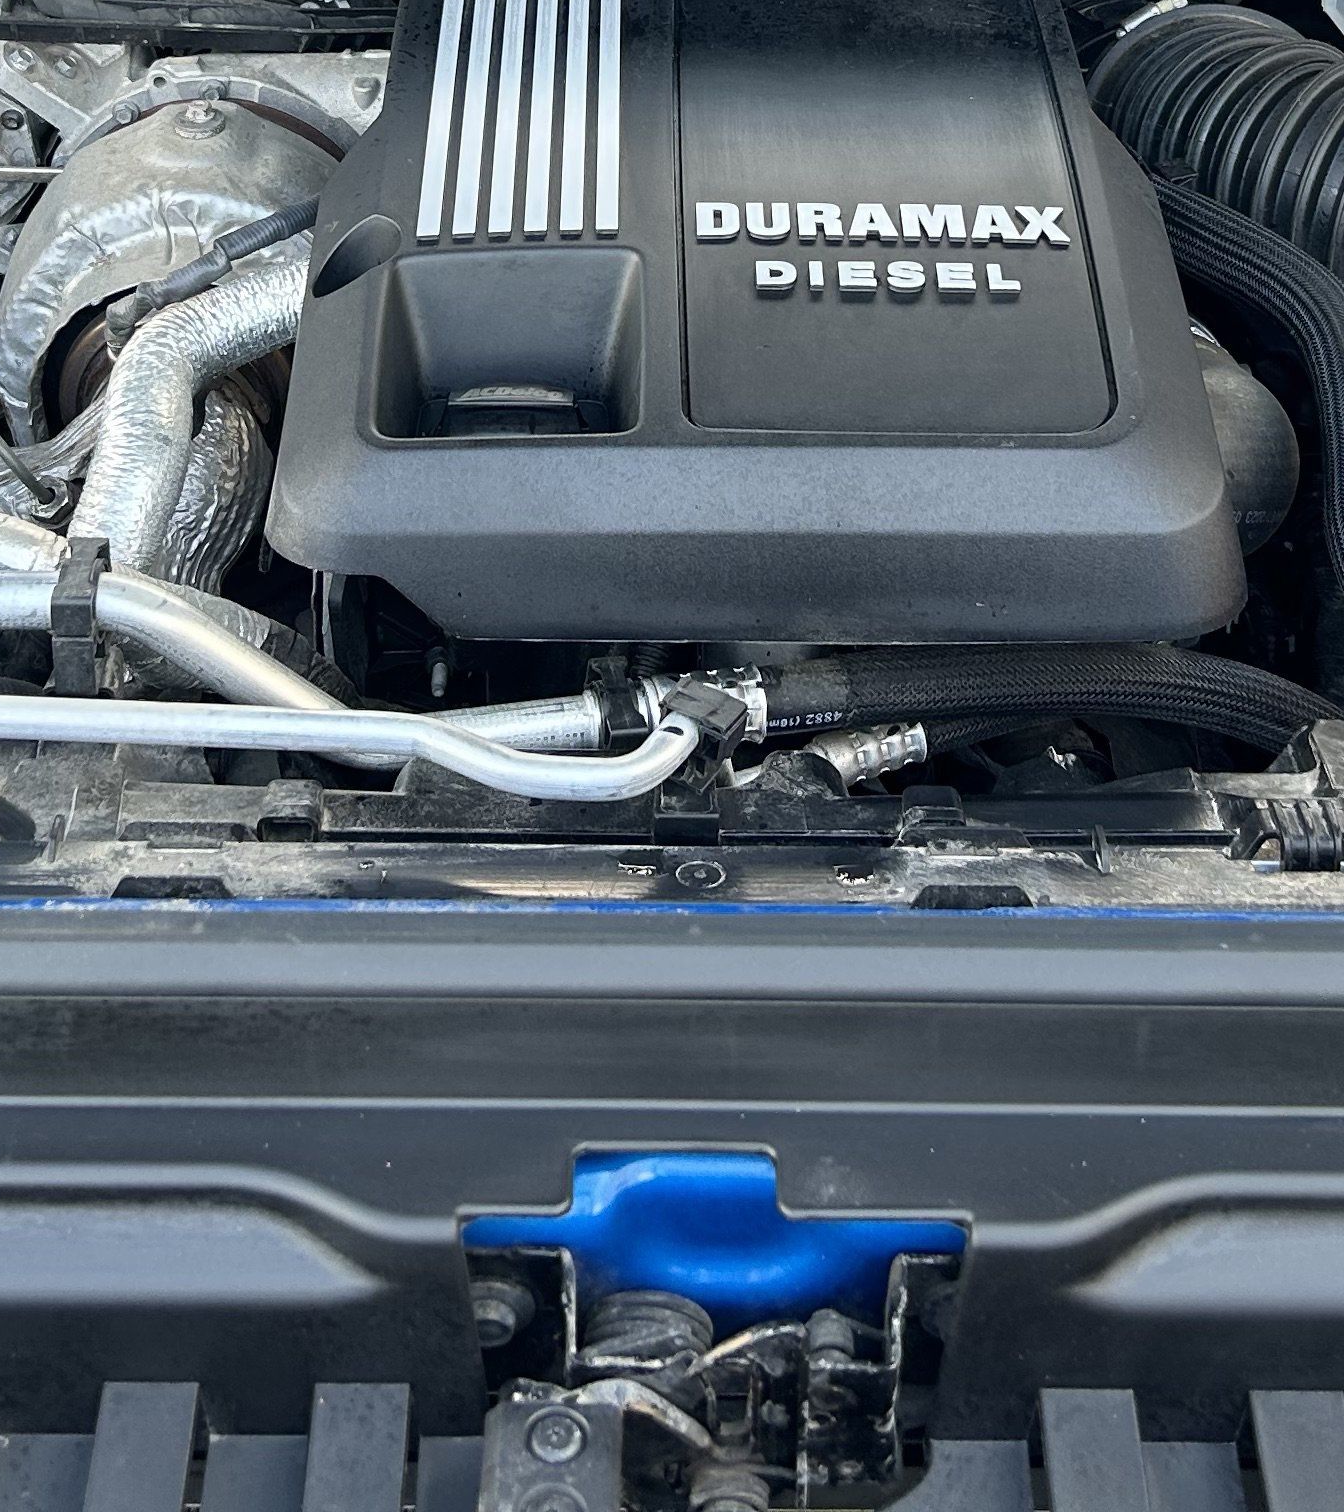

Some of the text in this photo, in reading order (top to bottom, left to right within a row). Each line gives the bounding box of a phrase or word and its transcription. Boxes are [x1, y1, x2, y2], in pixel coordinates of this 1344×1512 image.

[695, 201, 1071, 247] DURAMAX
[755, 260, 1022, 294] DIESEL
[766, 710, 843, 728] 4882 (16m
